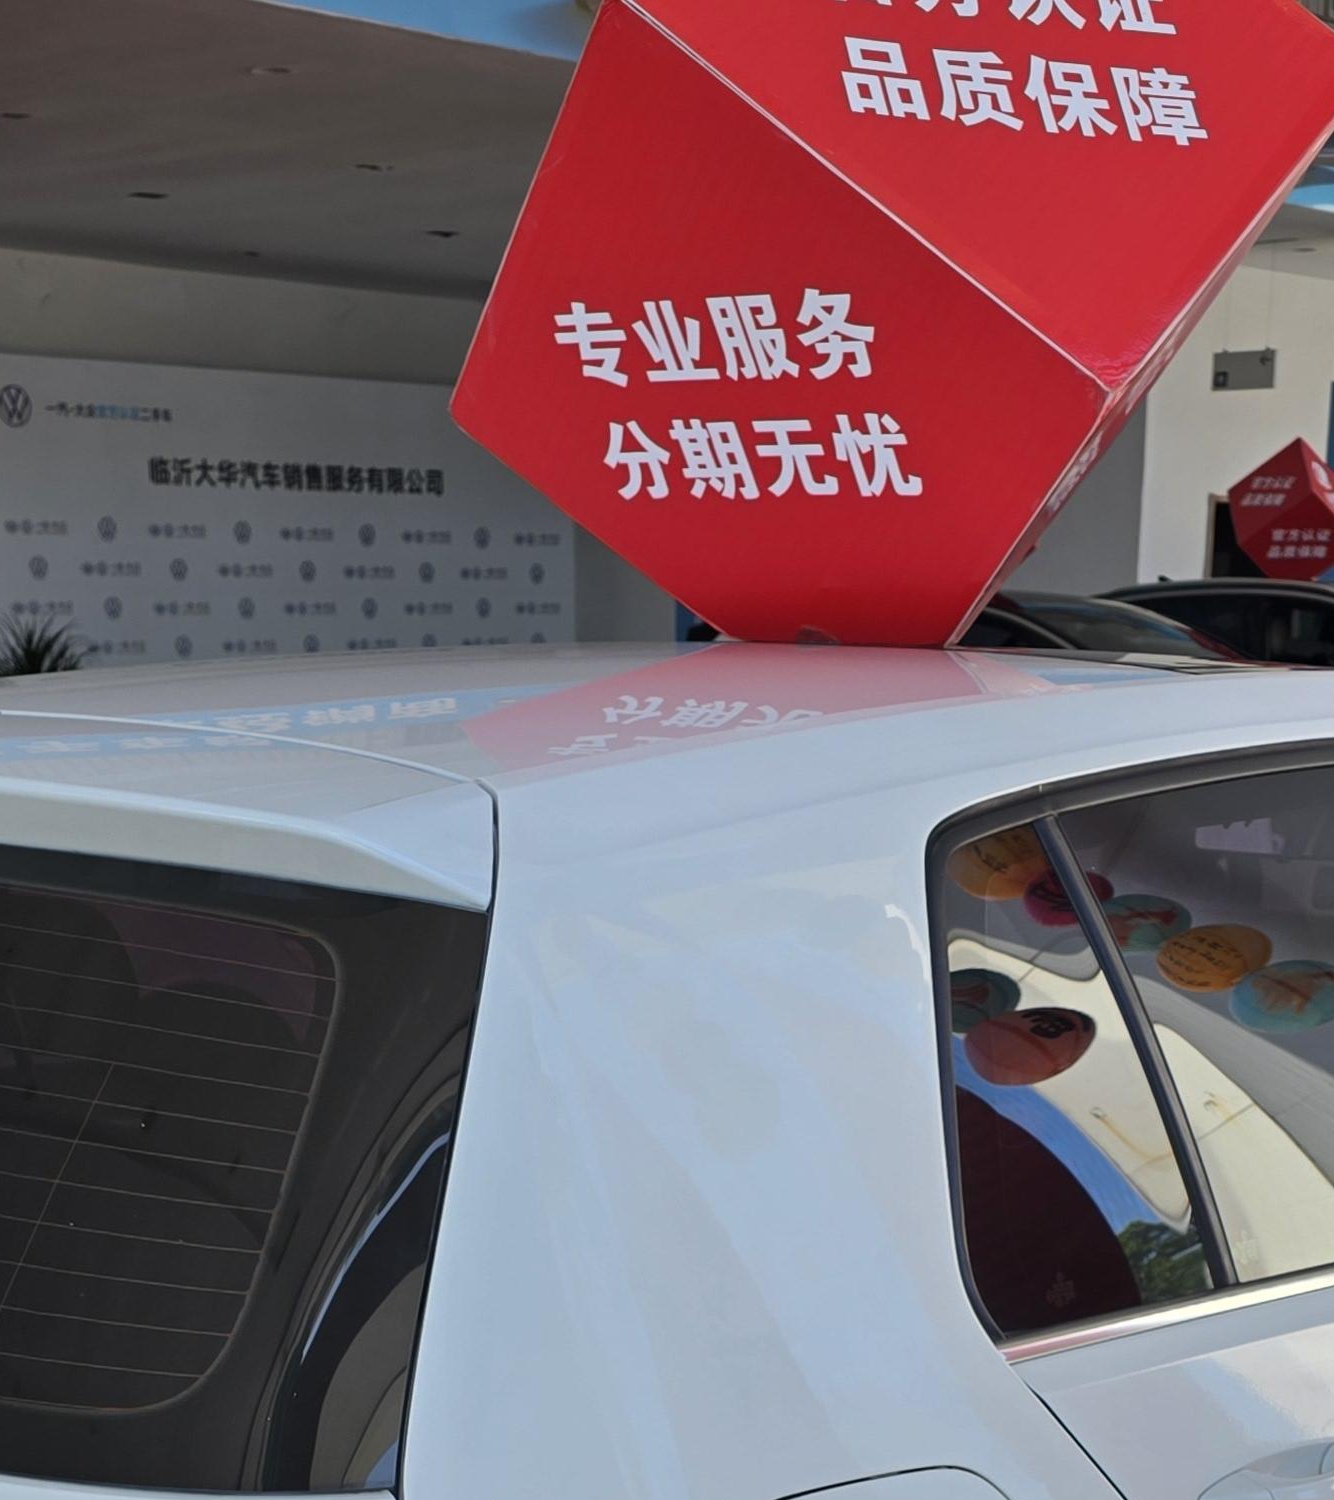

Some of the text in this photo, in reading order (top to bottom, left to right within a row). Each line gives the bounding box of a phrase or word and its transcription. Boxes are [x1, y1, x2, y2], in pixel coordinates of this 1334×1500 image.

[841, 36, 1209, 147] 品质保障
[554, 288, 875, 388] 专业服务
[148, 457, 444, 497] 临沂大华汽车销售服务有限公司
[603, 412, 924, 502] 分期无忧
